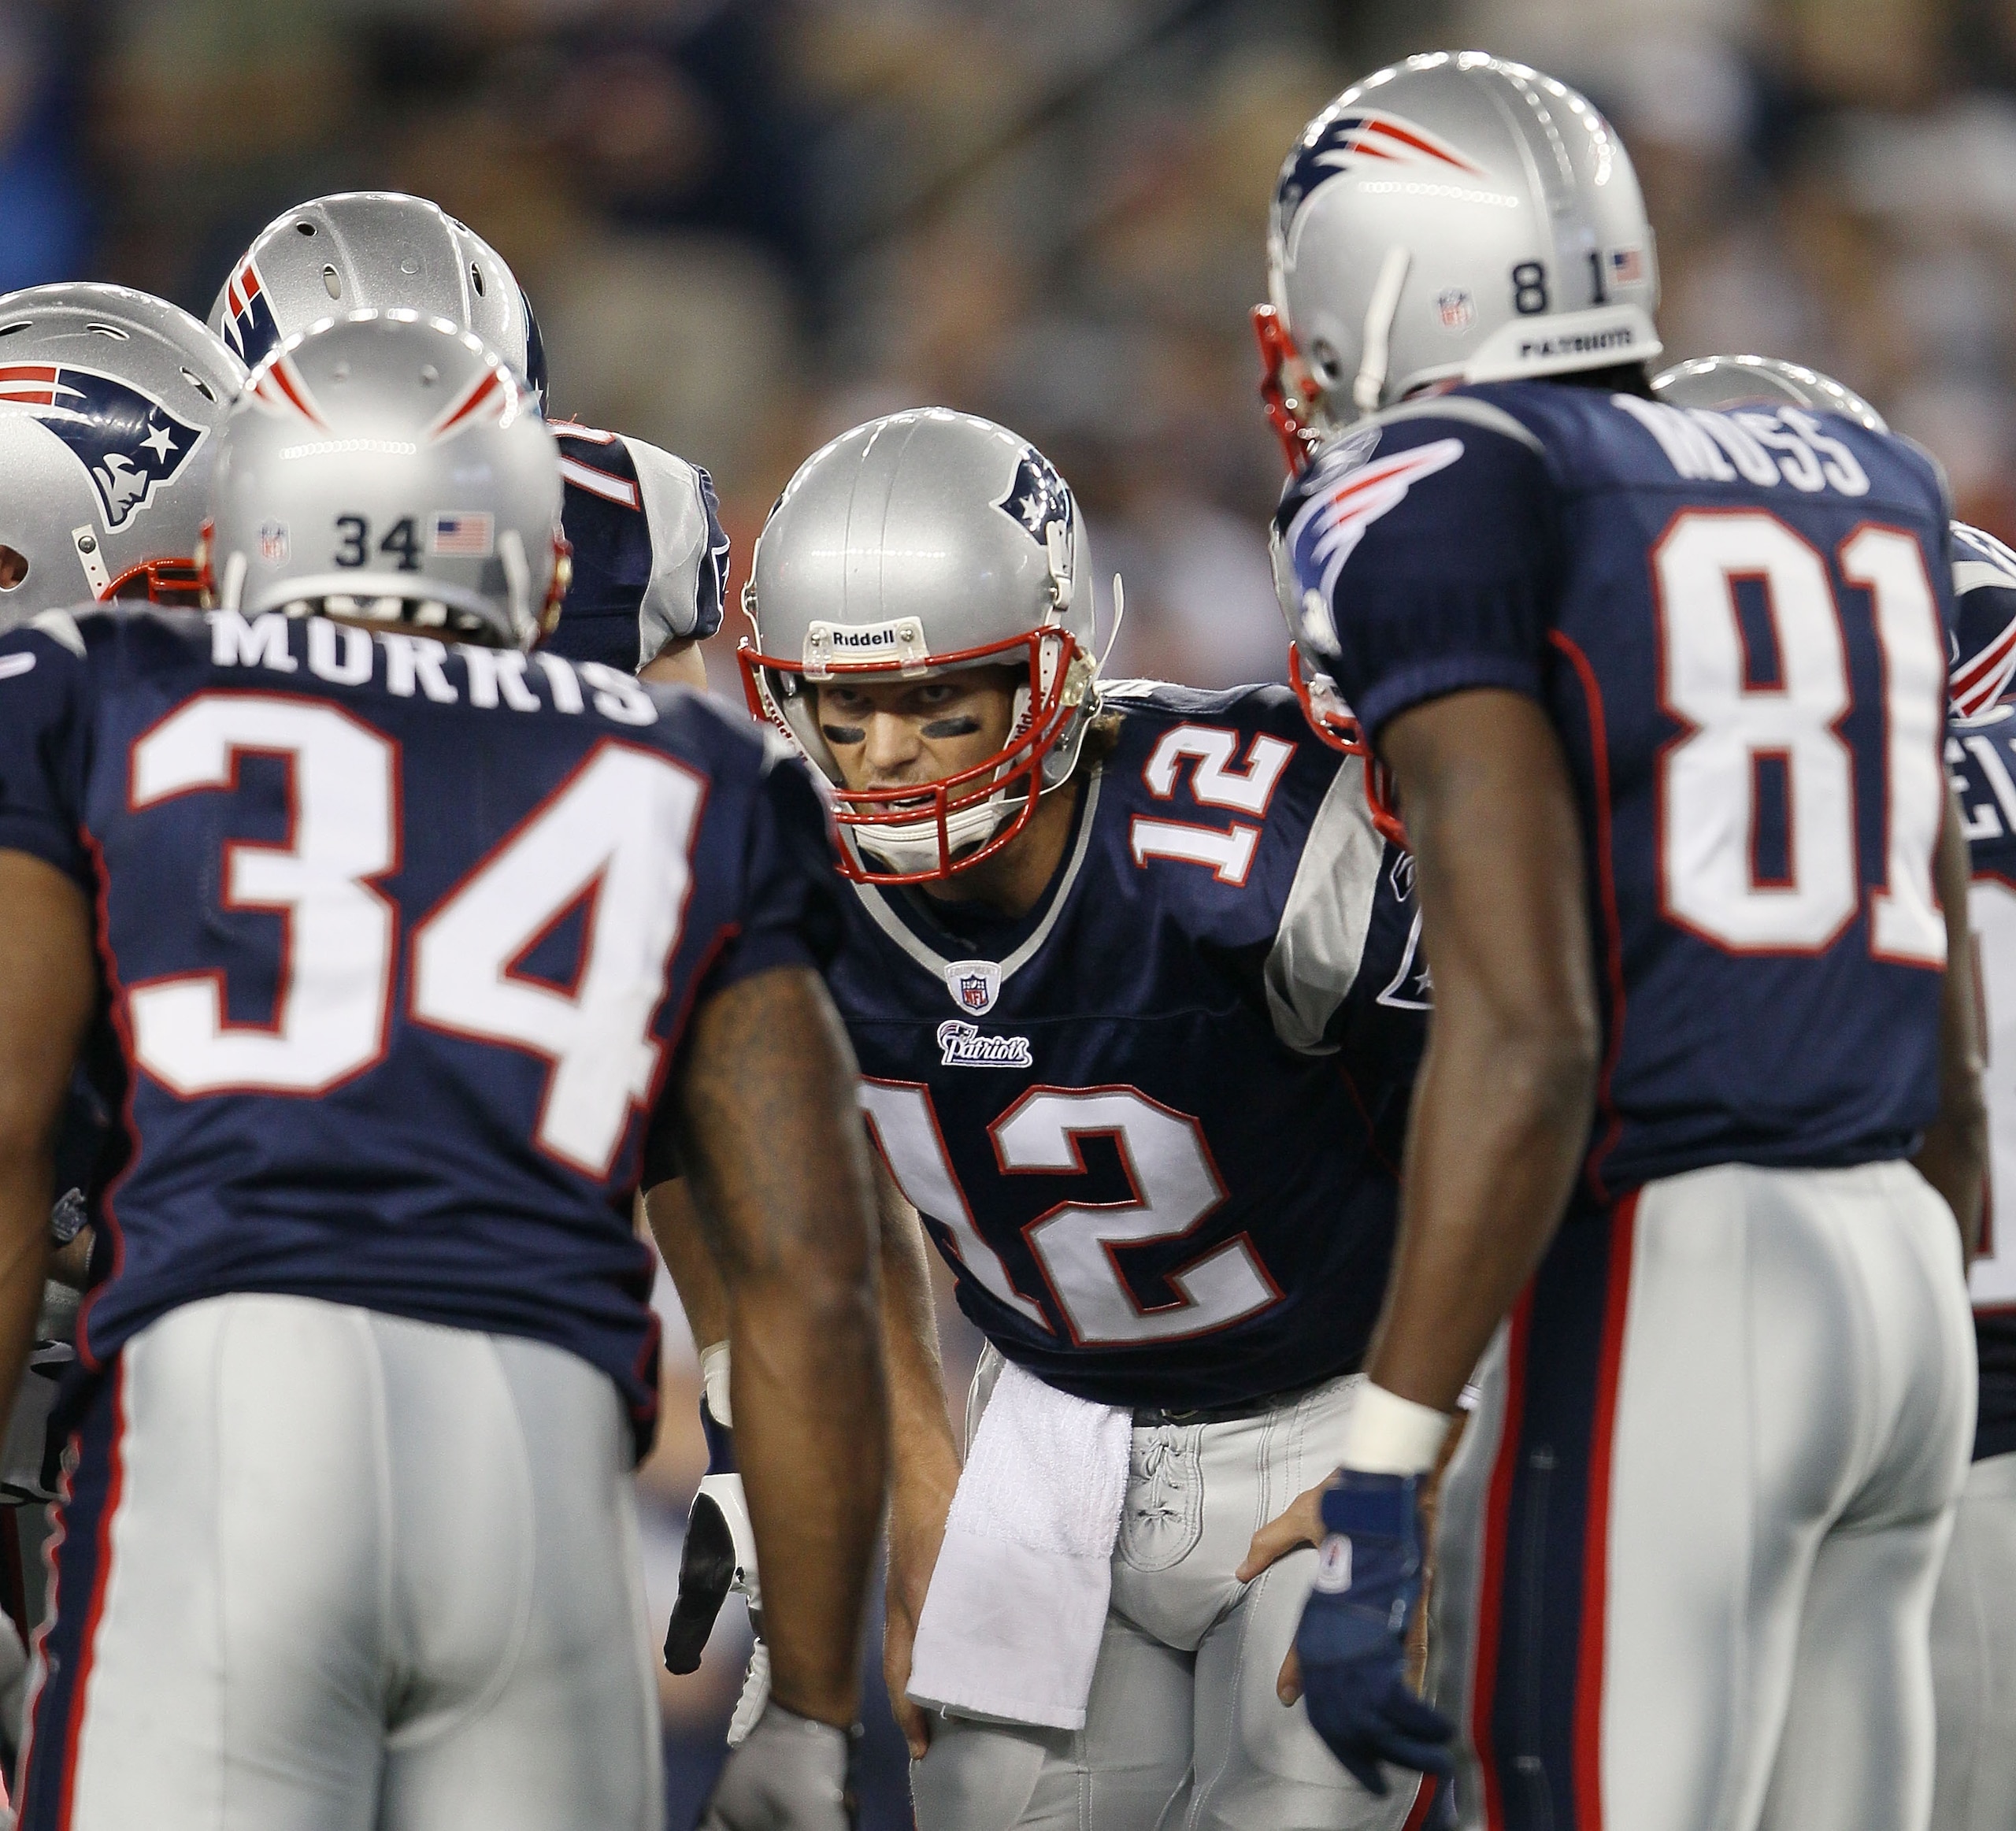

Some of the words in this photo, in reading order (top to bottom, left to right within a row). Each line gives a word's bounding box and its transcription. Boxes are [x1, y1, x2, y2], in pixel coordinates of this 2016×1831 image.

[1610, 393, 1871, 497] MOSS
[335, 514, 421, 571] 34
[206, 608, 658, 726] MORRIS
[832, 629, 895, 647] Riddell
[1651, 506, 1948, 971] 81
[1128, 720, 1299, 888] 12
[127, 688, 713, 1184] 34
[942, 1032, 1028, 1064] Patriots
[962, 989, 988, 1006] NFL
[859, 1073, 1287, 1347] 12
